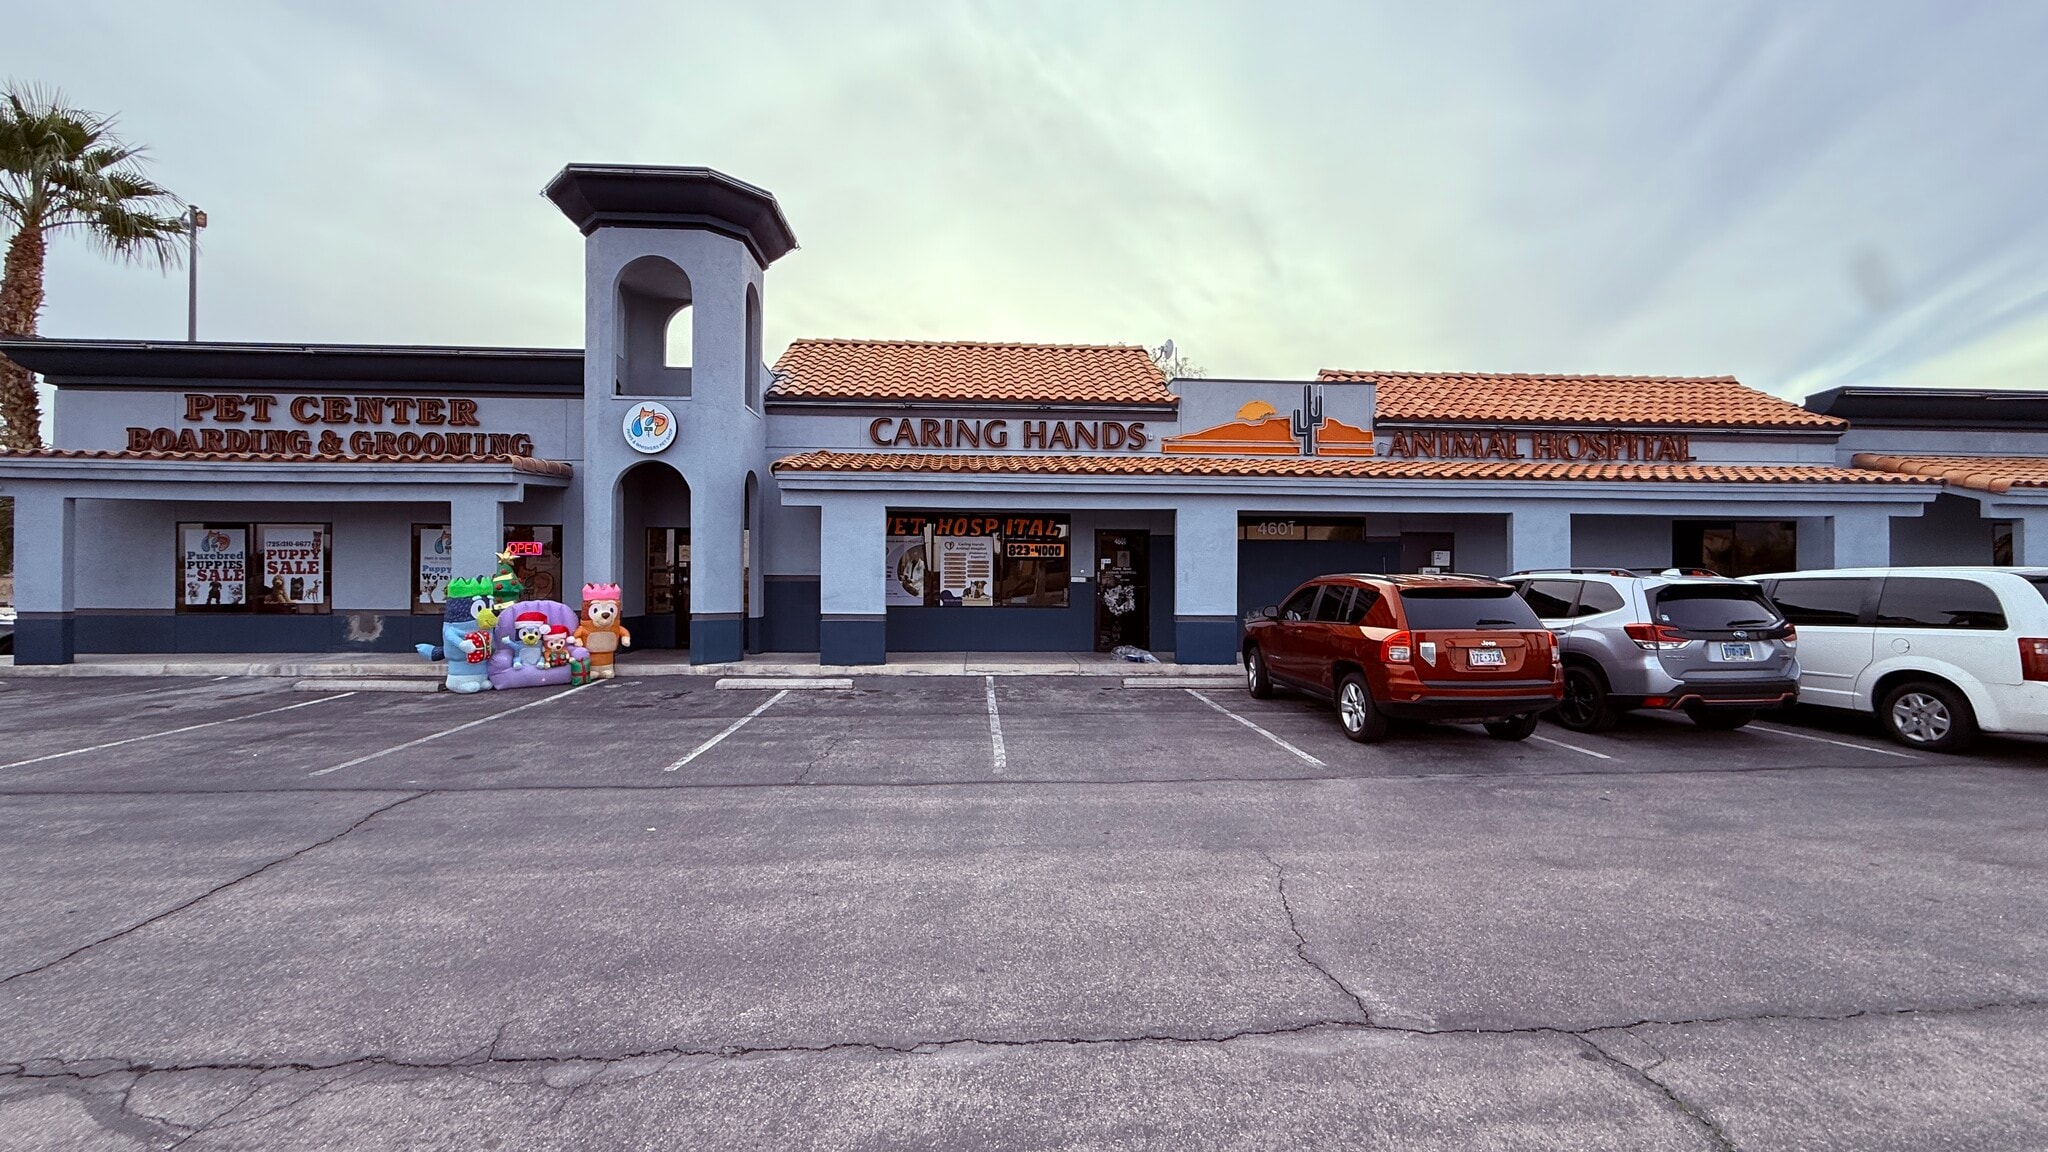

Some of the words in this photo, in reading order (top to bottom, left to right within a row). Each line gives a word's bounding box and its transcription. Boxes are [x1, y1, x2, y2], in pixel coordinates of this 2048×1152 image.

[184, 394, 277, 422] PET
[290, 397, 480, 426] CENTER
[869, 418, 1008, 448] CARING
[1023, 420, 1147, 450] HANDS
[126, 428, 312, 454] BOARDING
[318, 430, 343, 454] &
[350, 431, 534, 457] GROOMING
[1387, 430, 1525, 459] ANIMAL
[1532, 432, 1698, 462] HOSPITAL
[1257, 521, 1296, 536] 4601
[266, 549, 321, 560] PUPPY
[509, 543, 540, 554] OPEN
[187, 551, 244, 560] Purebred
[187, 561, 243, 570] PUPPIES
[267, 561, 320, 575] SALE
[422, 565, 452, 574] Puppy
[197, 569, 245, 582] SALE
[422, 573, 448, 581] We're
